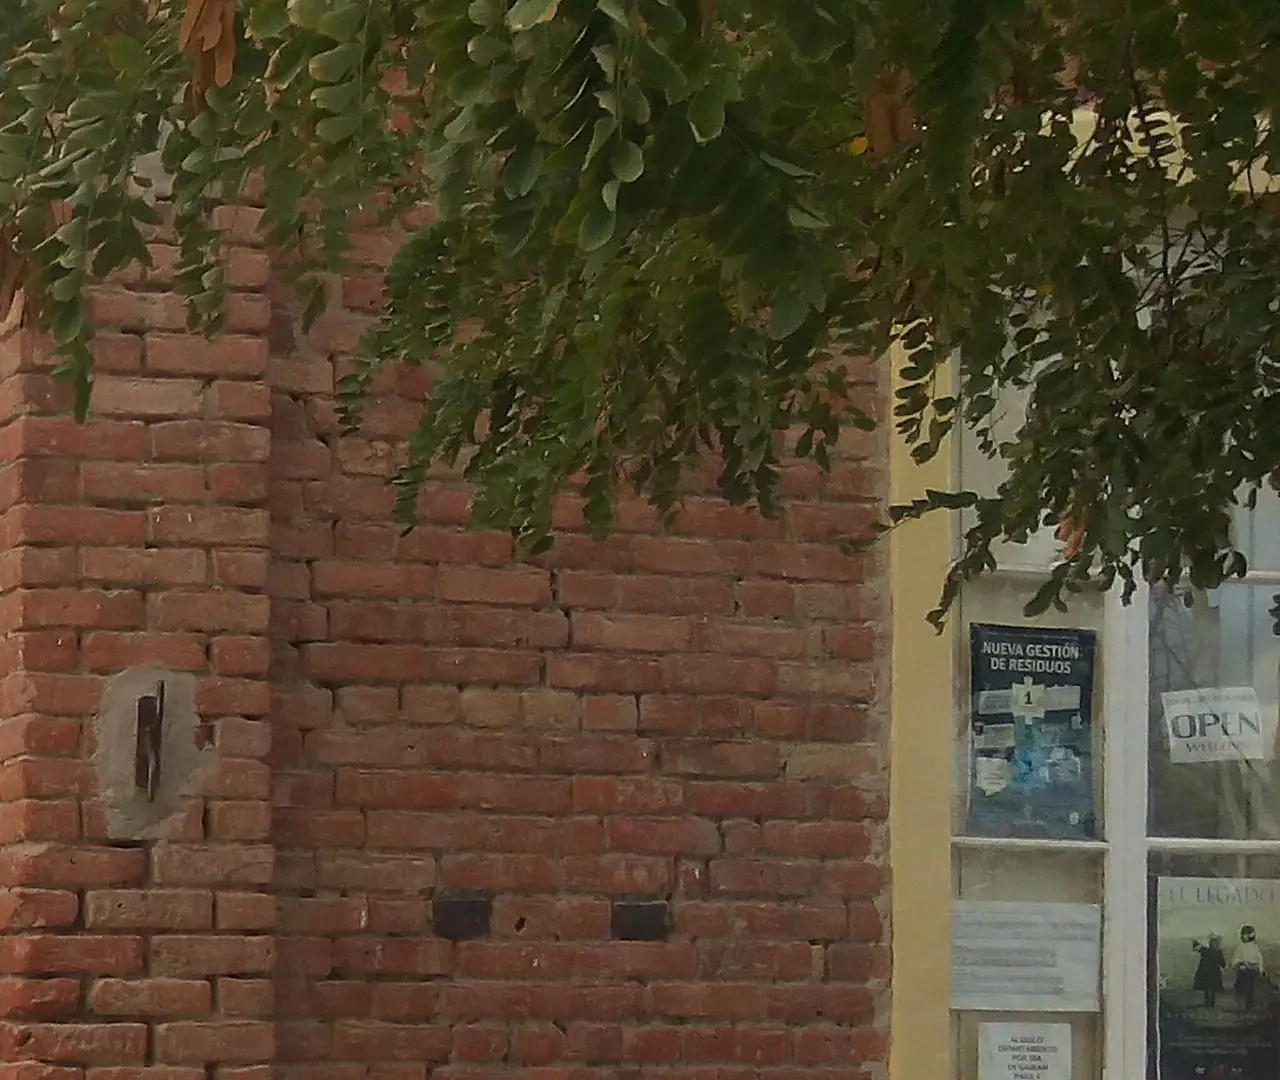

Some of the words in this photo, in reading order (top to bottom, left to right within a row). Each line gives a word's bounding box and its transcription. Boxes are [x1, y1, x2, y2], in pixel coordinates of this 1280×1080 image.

[981, 641, 1024, 656] NUEVA
[1026, 641, 1080, 660] GESTIÓN
[990, 657, 1006, 670] DE
[1008, 659, 1071, 674] RESIDUOS
[1023, 690, 1033, 705] 1
[1171, 711, 1261, 739] OPEN
